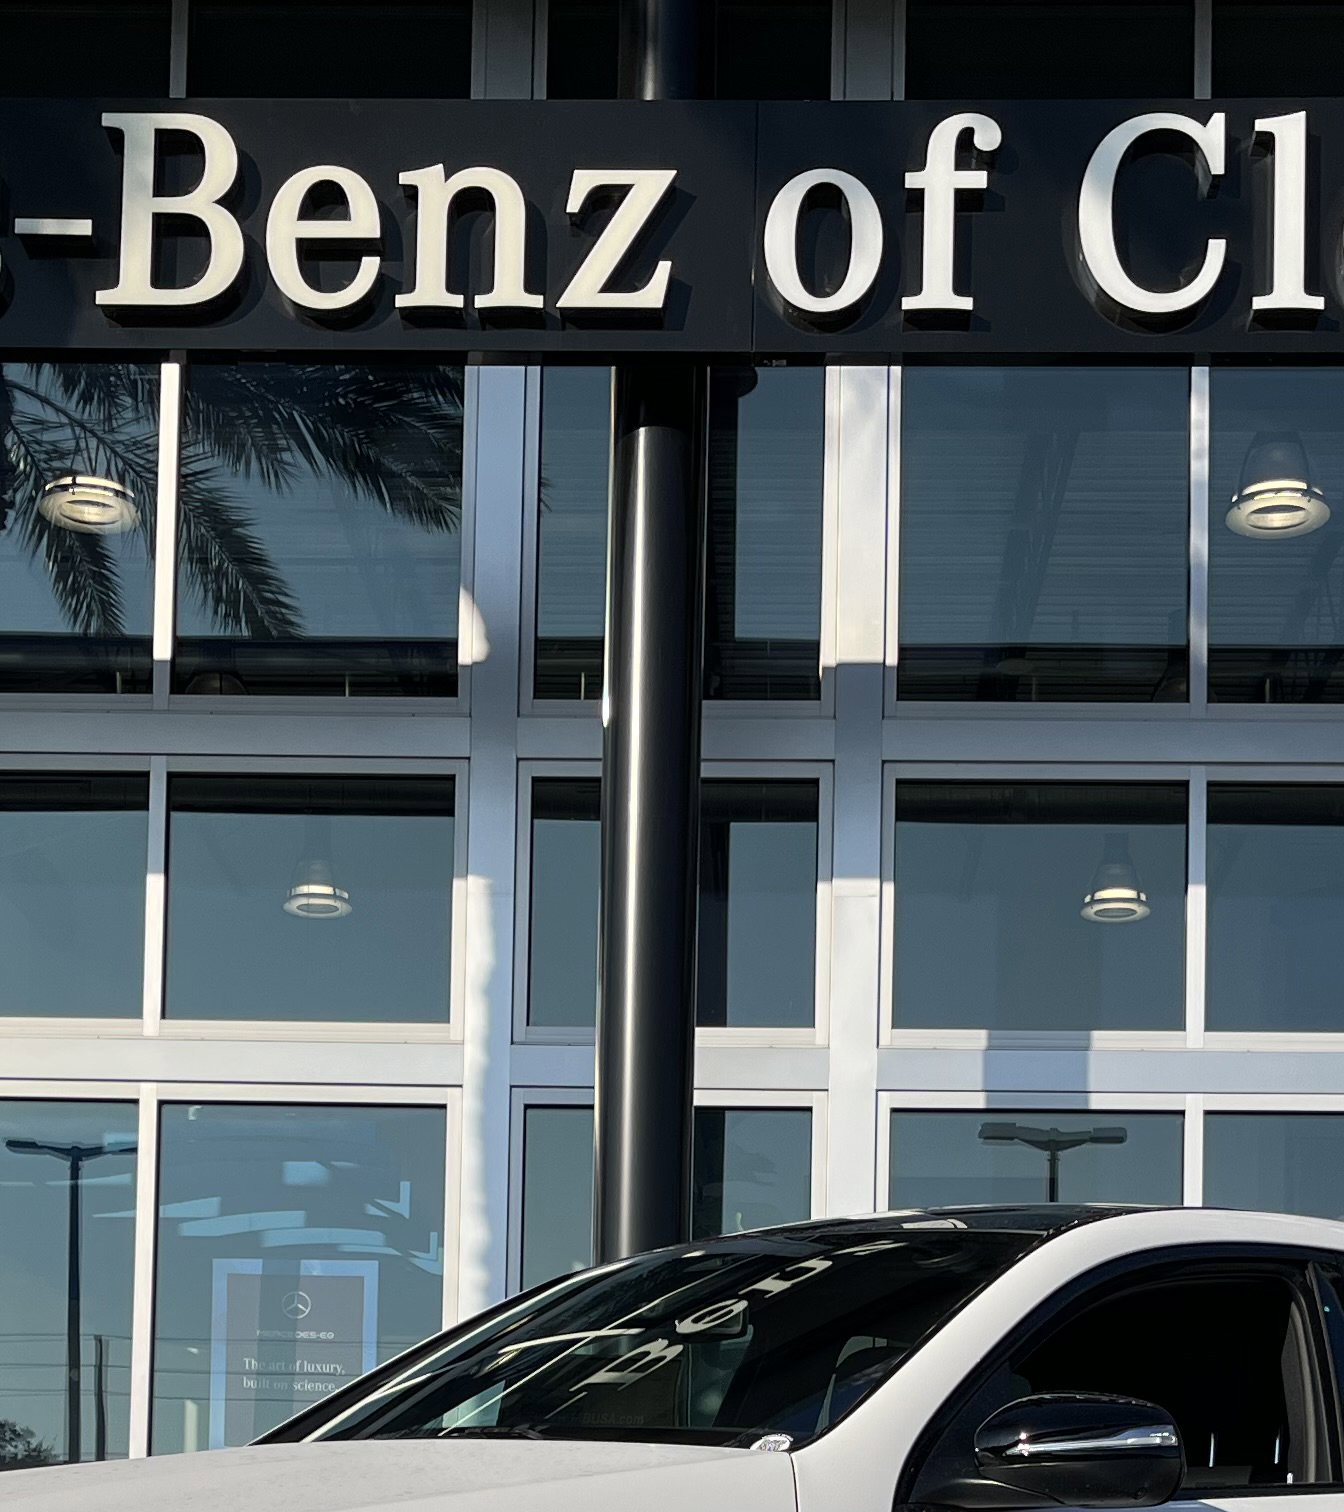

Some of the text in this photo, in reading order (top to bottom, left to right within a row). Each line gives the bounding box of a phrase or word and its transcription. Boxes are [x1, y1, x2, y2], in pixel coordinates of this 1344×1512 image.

[763, 112, 1002, 313] of
[243, 1357, 346, 1375] The art of luxury,
[243, 1376, 270, 1389] built
[273, 1382, 288, 1391] on
